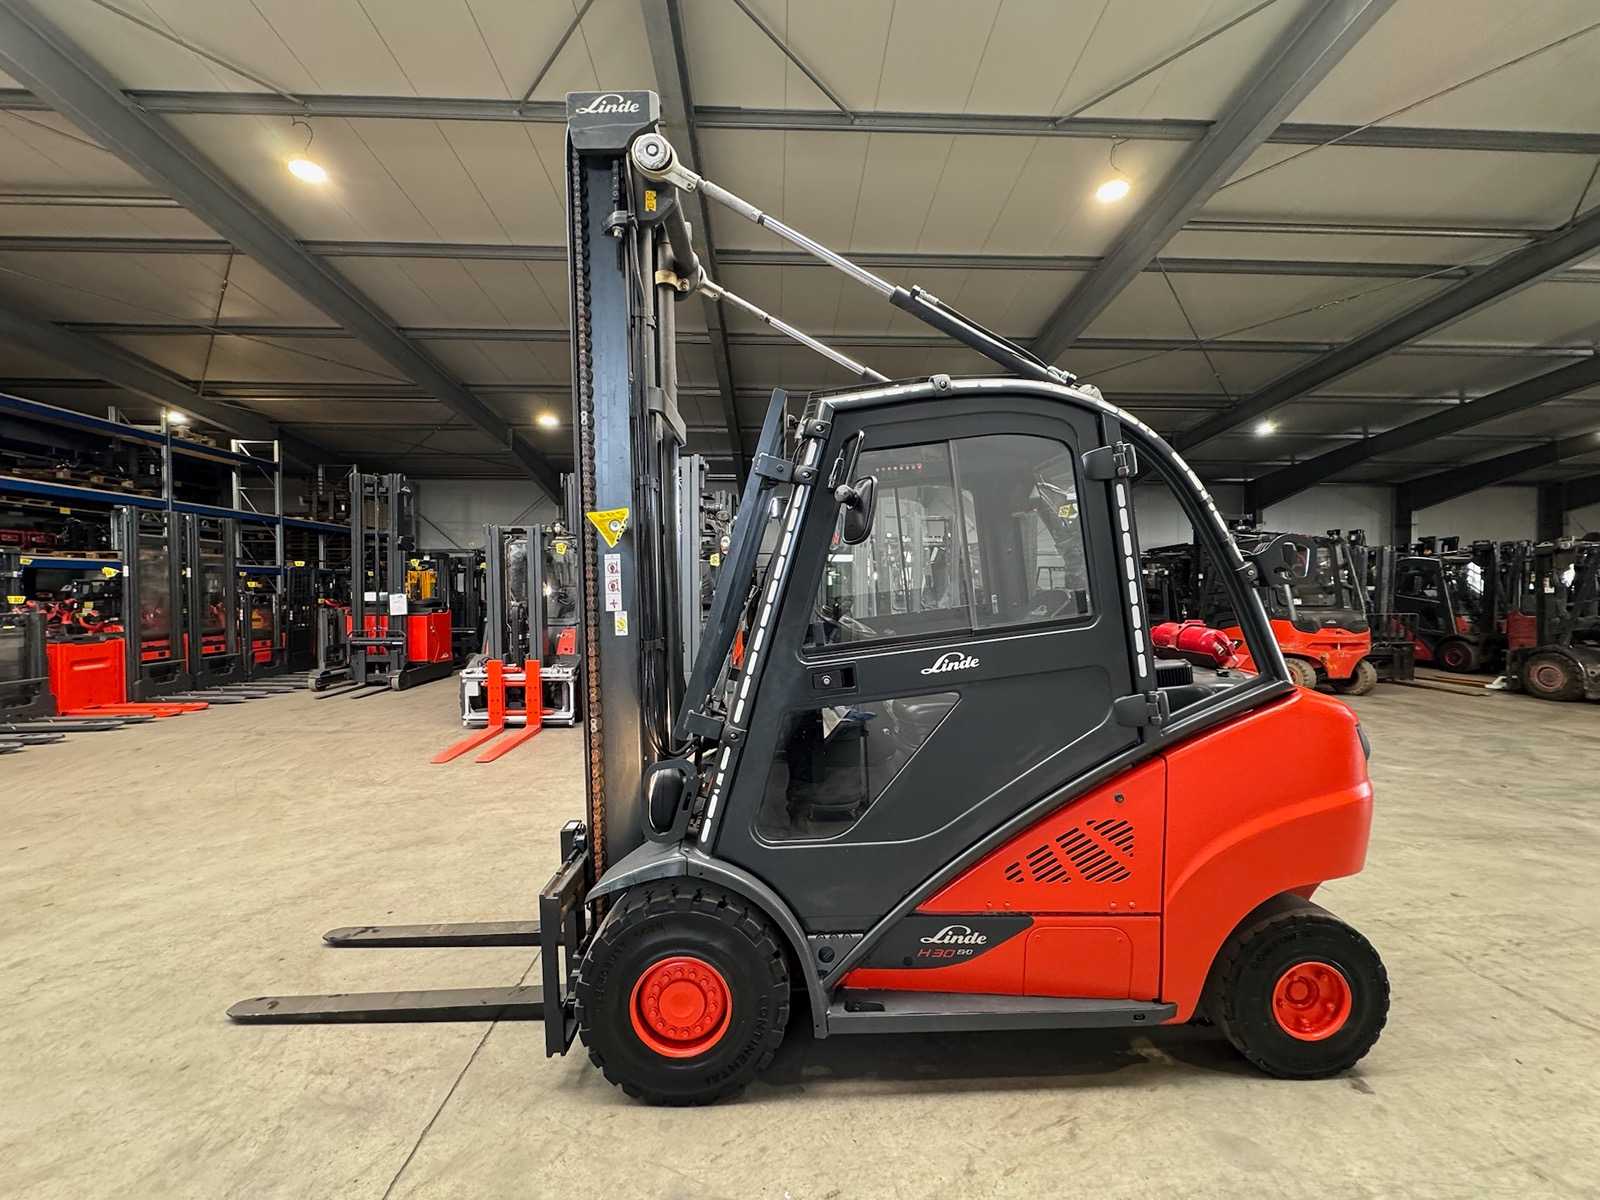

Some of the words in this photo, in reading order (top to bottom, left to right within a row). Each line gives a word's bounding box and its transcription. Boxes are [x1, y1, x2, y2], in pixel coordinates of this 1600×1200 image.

[576, 94, 640, 113] Linde
[921, 652, 980, 674] Linde
[920, 925, 987, 944] Linde
[917, 948, 956, 958] H30
